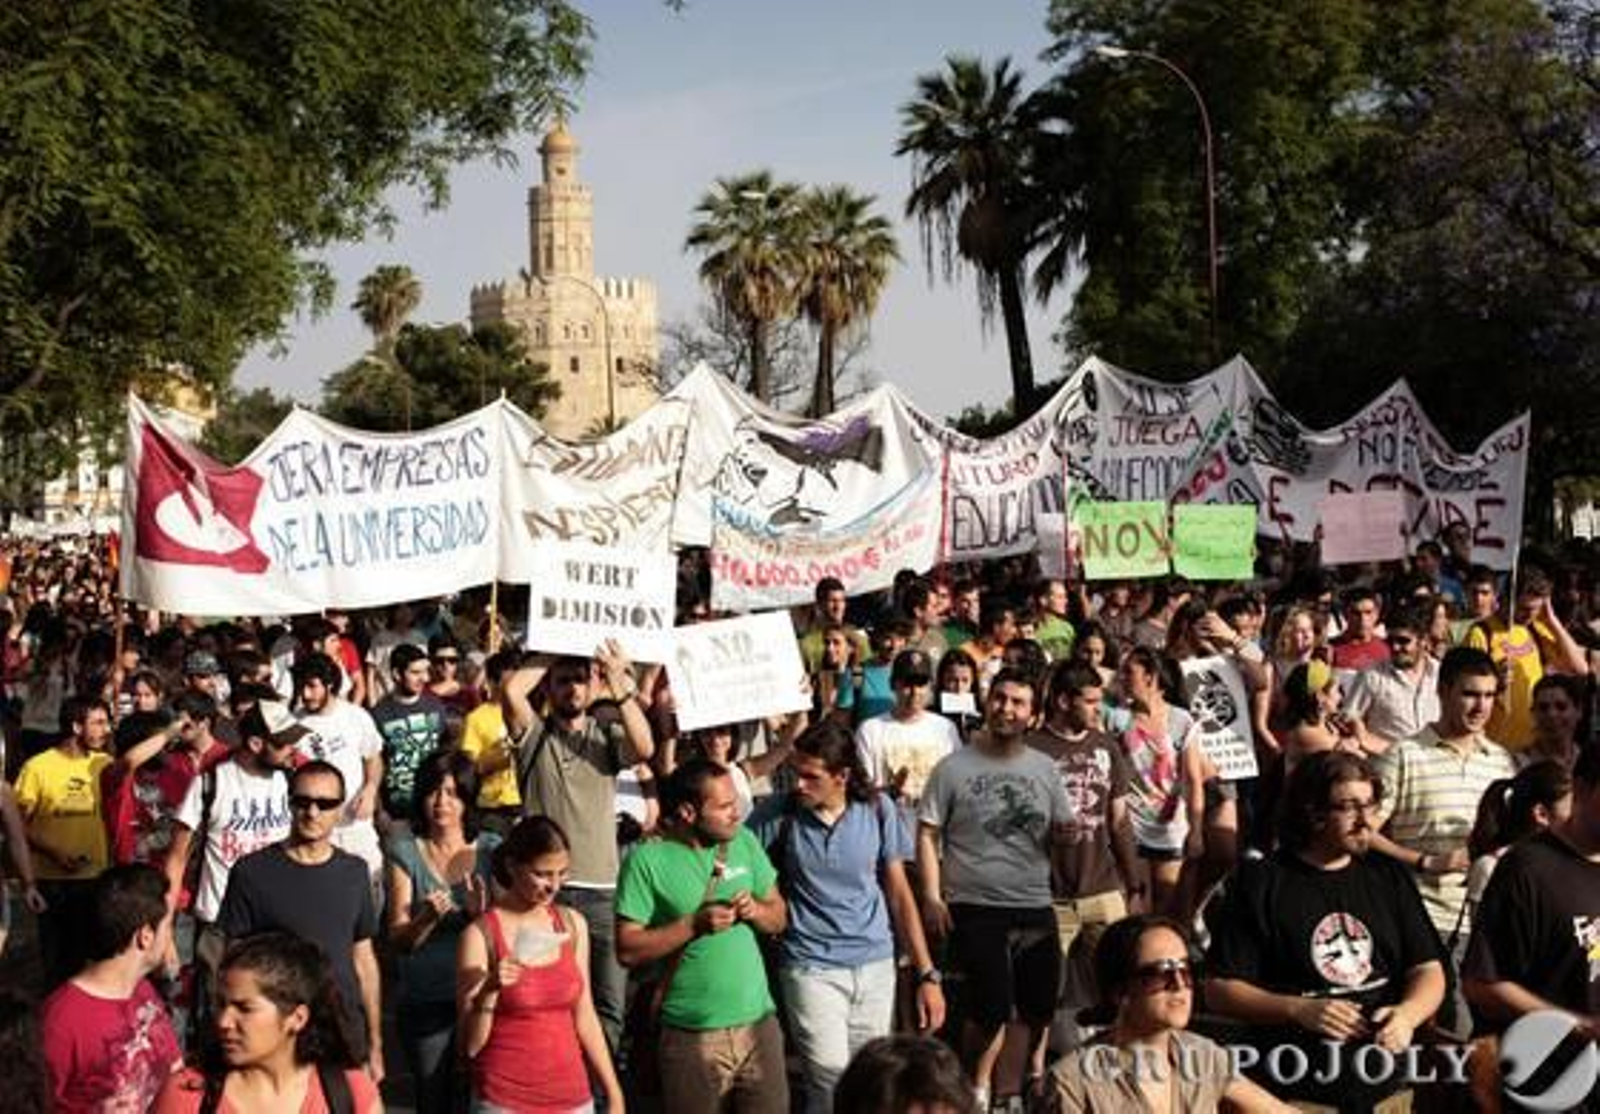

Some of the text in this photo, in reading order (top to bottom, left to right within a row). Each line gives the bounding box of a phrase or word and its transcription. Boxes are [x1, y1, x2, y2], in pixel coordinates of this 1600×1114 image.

[1108, 414, 1205, 449] JUEGA
[339, 426, 488, 493] EMPRESAS
[338, 496, 489, 567] UNIVERSIDAD
[564, 559, 640, 590] WERT
